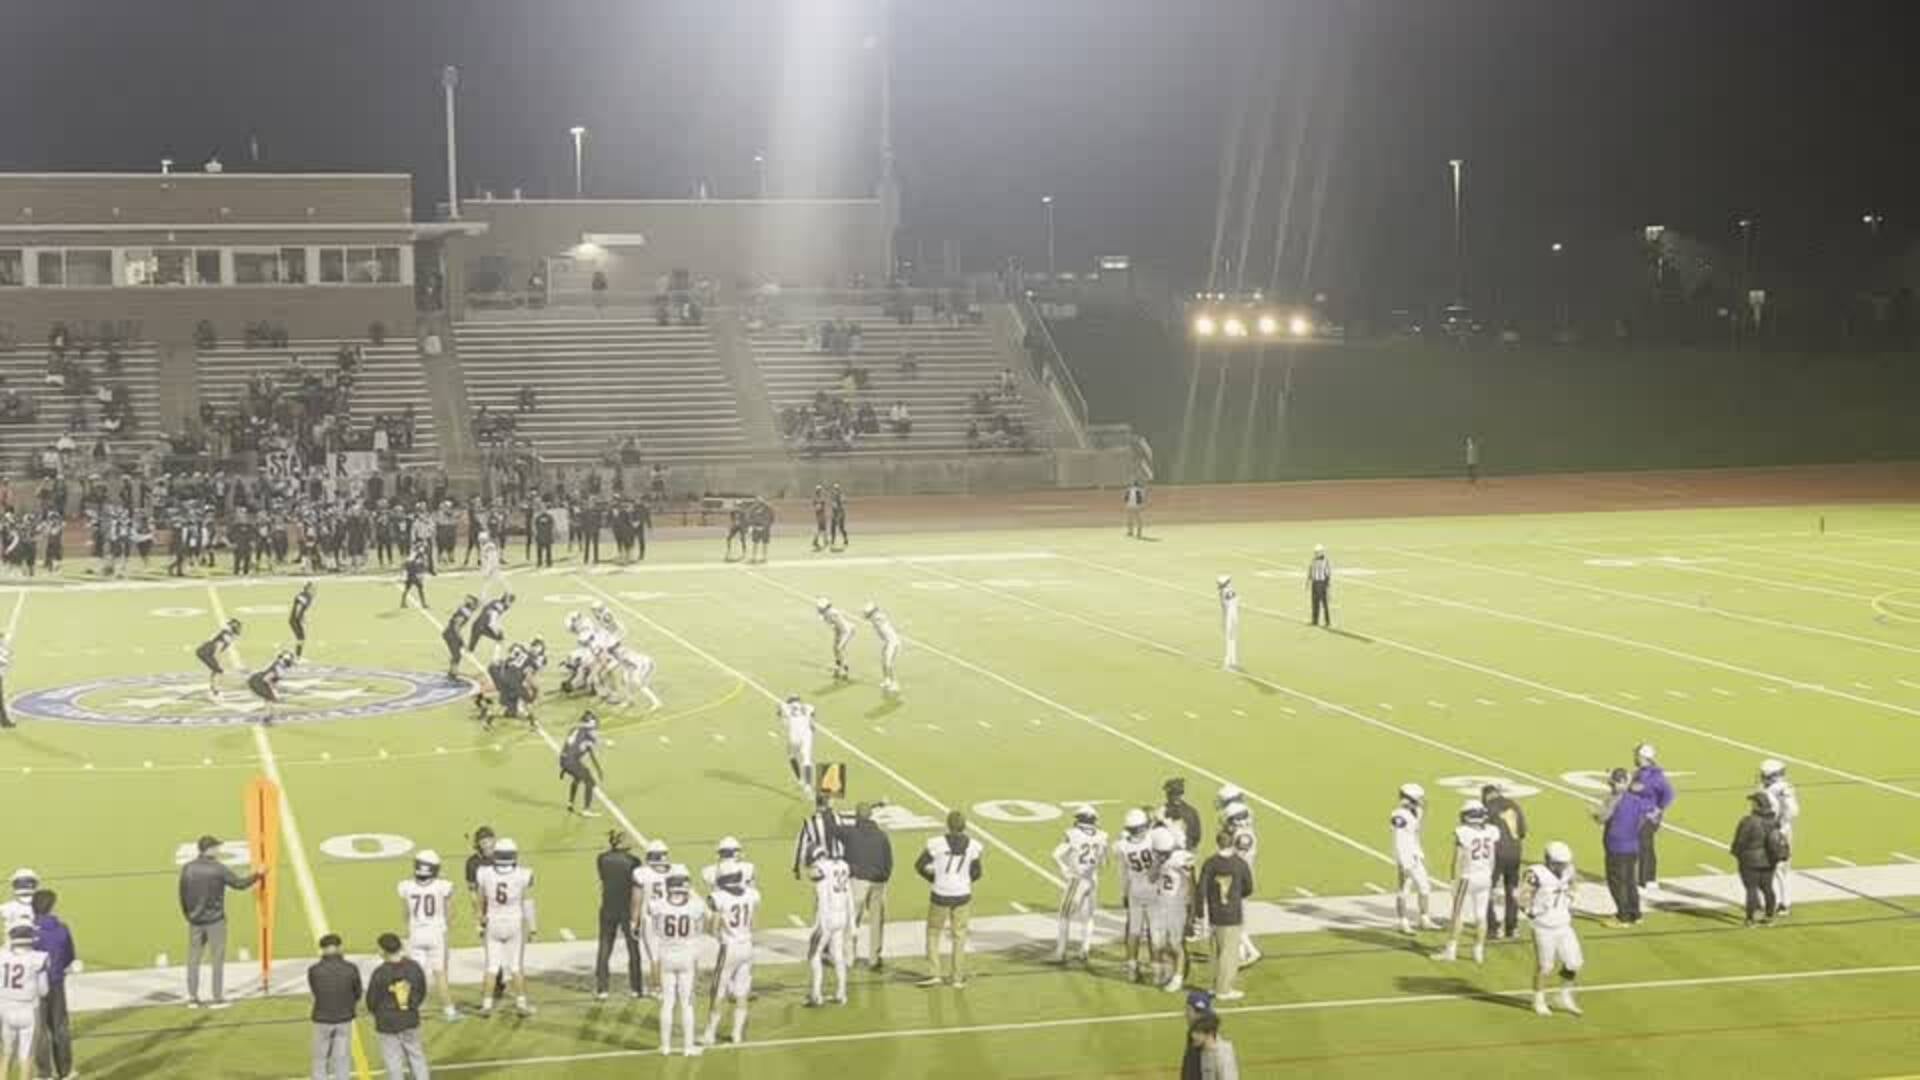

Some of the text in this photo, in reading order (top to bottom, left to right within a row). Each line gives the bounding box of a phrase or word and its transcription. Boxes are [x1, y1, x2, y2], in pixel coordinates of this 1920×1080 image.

[320, 833, 414, 859] 0
[1471, 838, 1490, 860] 25
[1128, 848, 1152, 872] 59
[411, 895, 436, 917] 70
[495, 884, 507, 904] 6
[664, 914, 690, 938] 60
[729, 903, 749, 928] 31
[2, 962, 26, 990] 12
